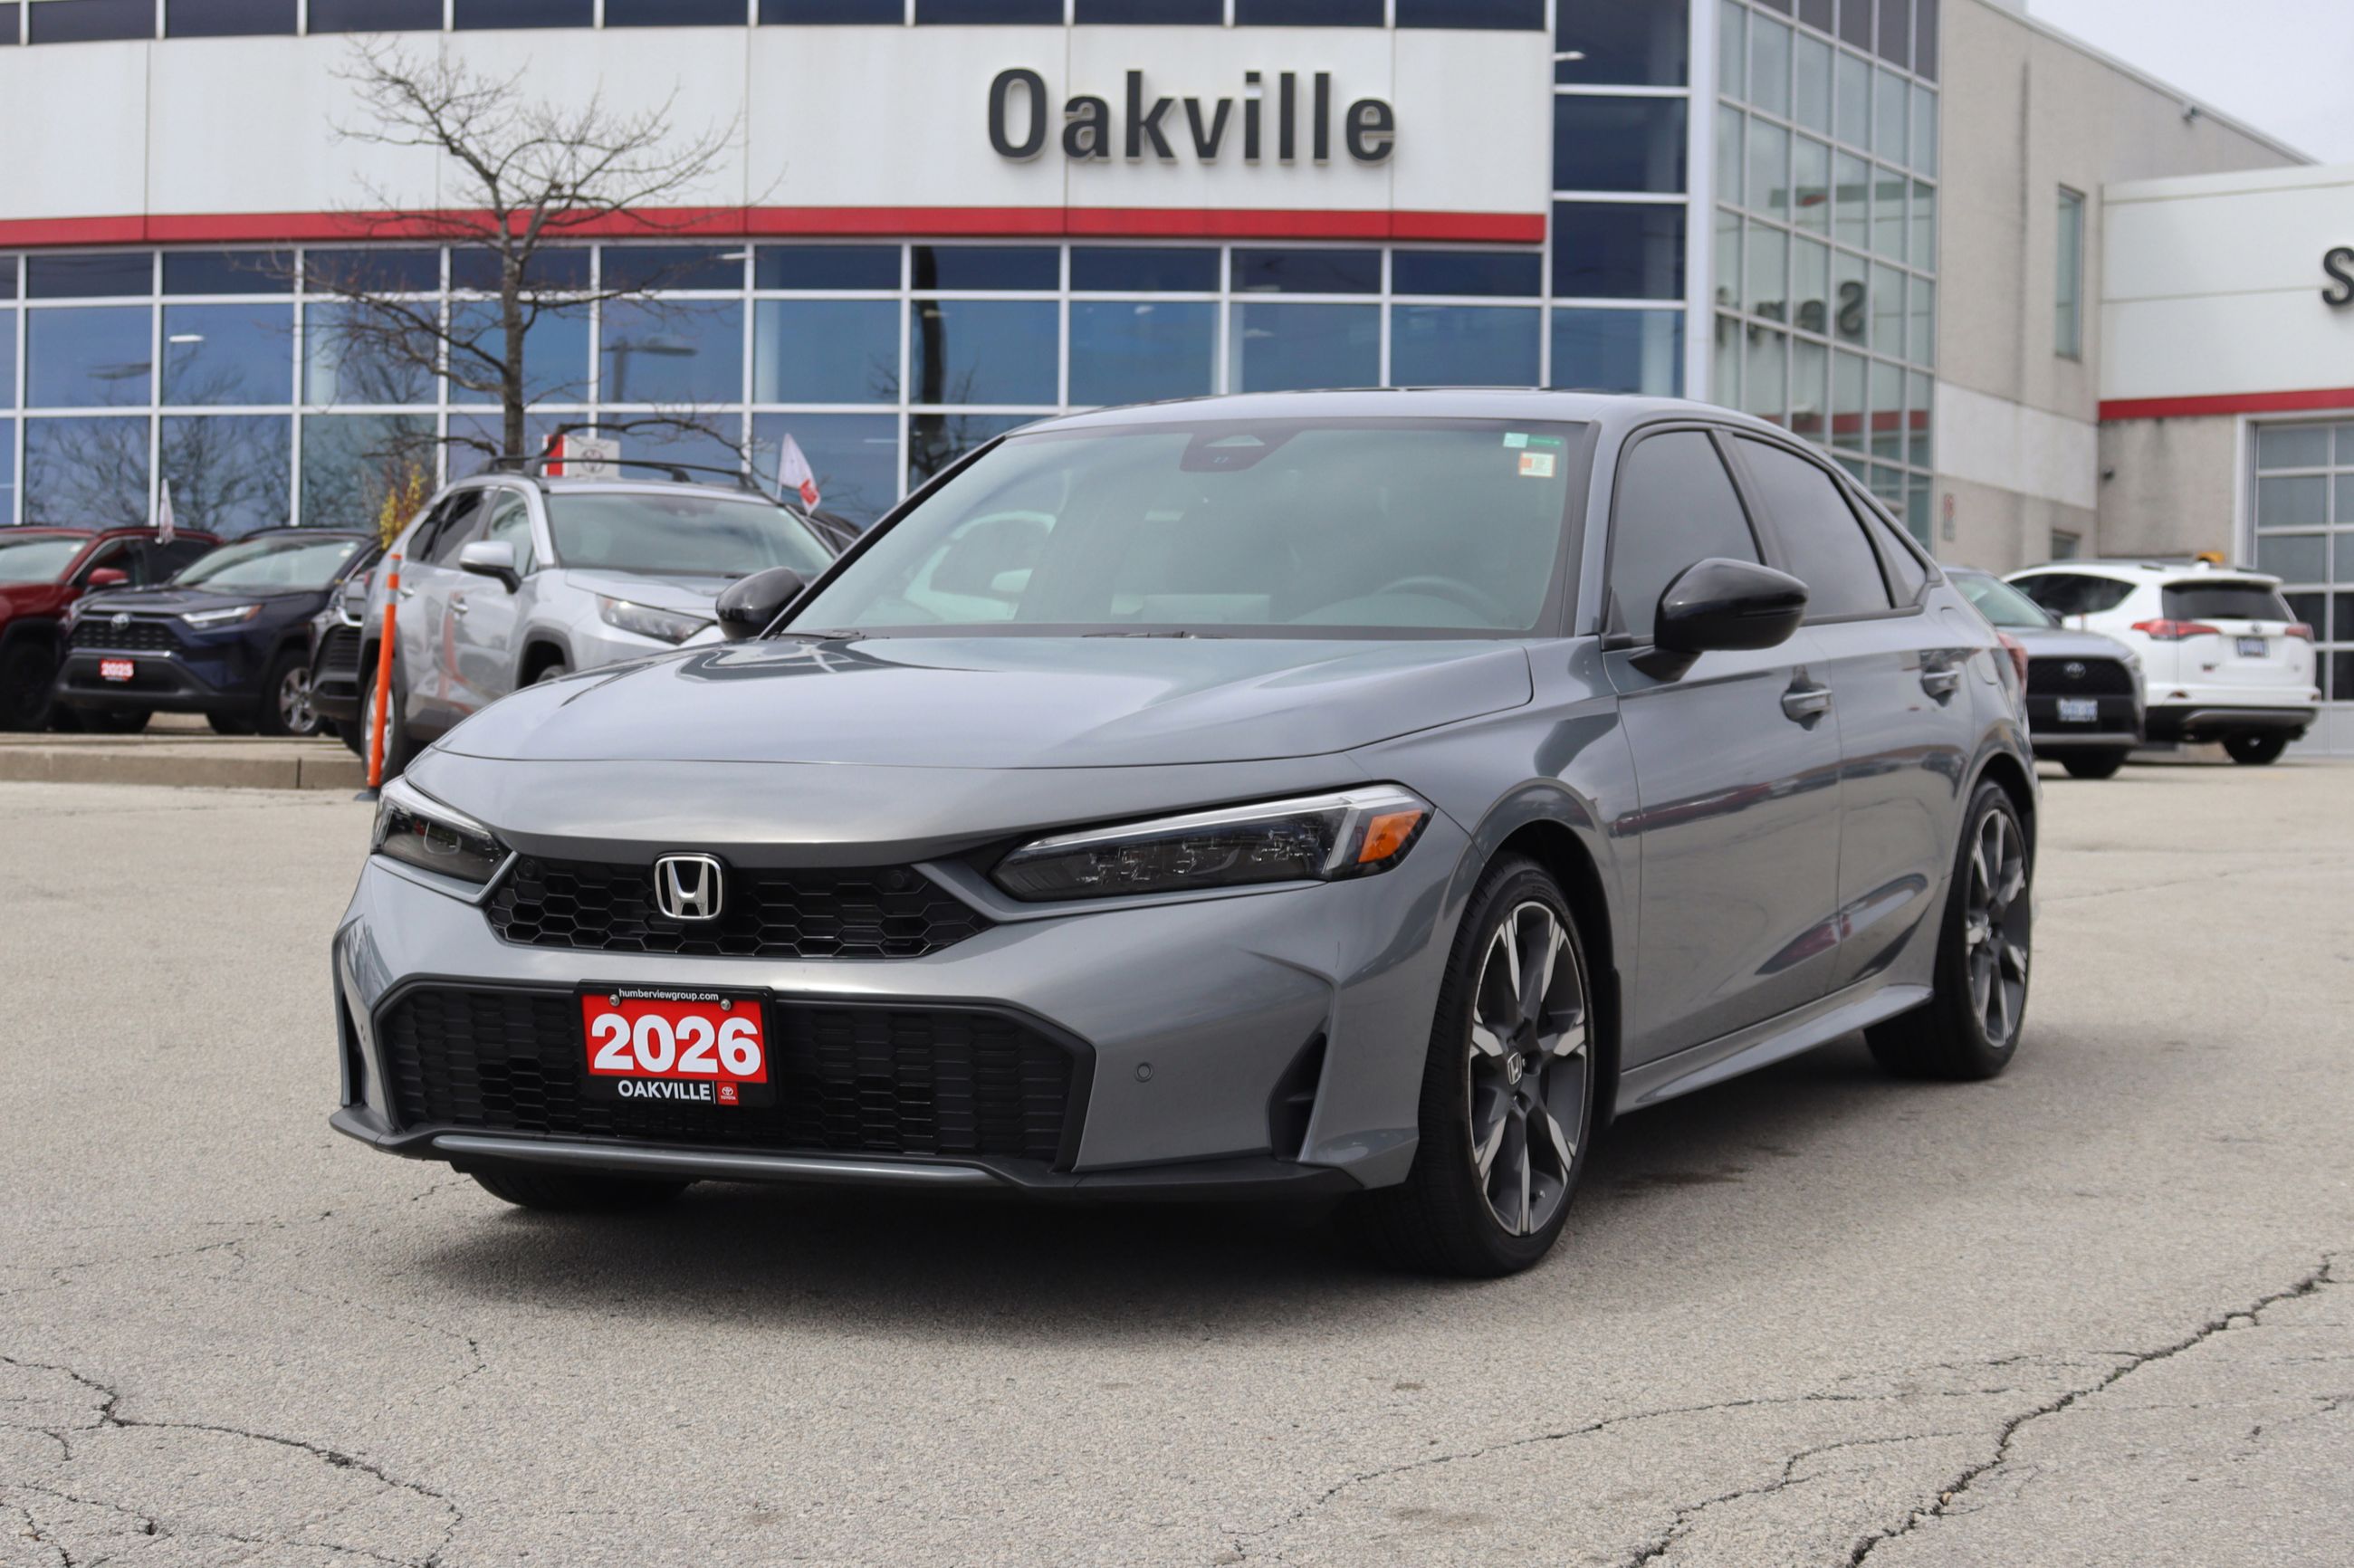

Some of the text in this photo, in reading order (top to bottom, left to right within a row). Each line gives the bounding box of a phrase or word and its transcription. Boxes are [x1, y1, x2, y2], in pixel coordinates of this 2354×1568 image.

[988, 67, 1395, 164] Oakville
[618, 988, 719, 1001] humberviewgroup.com
[591, 1013, 761, 1076] 2026
[617, 1079, 712, 1101] OAKVILLE
